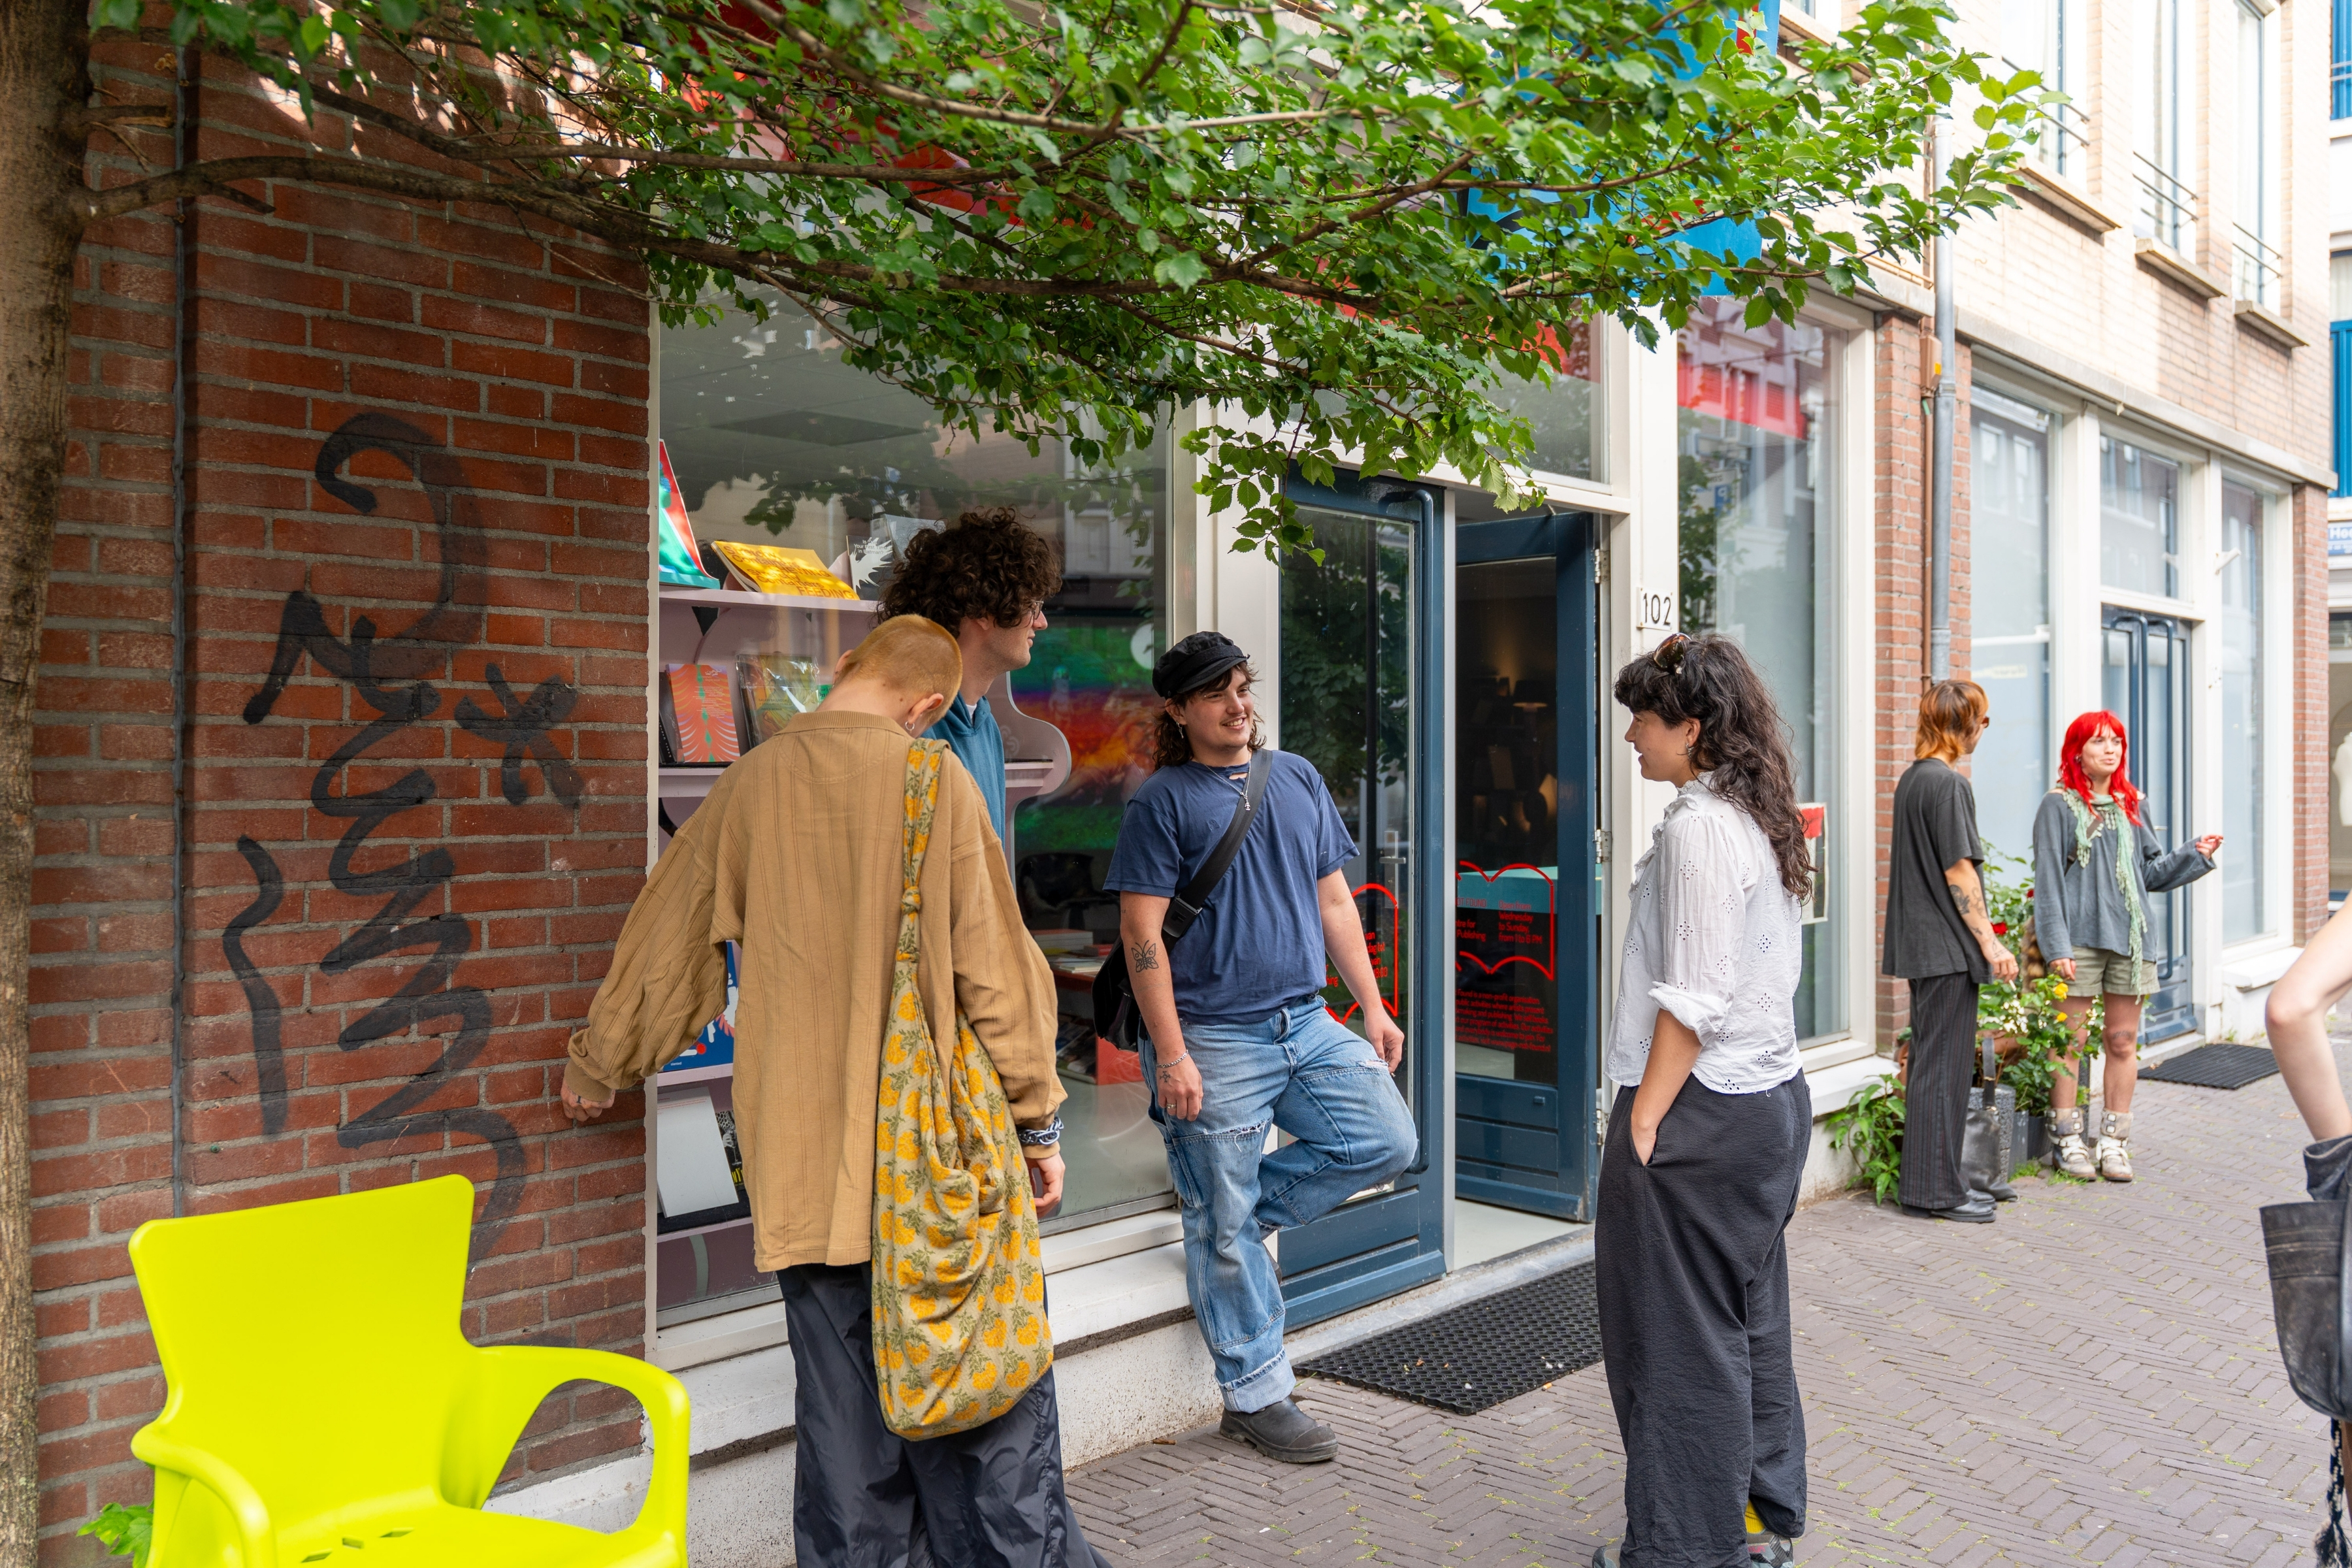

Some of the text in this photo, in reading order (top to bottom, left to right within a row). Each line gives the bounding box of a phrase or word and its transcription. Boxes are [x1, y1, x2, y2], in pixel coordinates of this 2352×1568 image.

[731, 554, 800, 569] Containers
[756, 576, 825, 589] Containers
[796, 585, 855, 600] FEEDING
[1642, 592, 1671, 626] 102
[1499, 901, 1514, 910] Open
[1498, 911, 1533, 923] Wednesday
[1365, 932, 1375, 940] van
[1457, 929, 1486, 941] Publishing
[1498, 932, 1513, 941] from
[1526, 934, 1530, 943] 6
